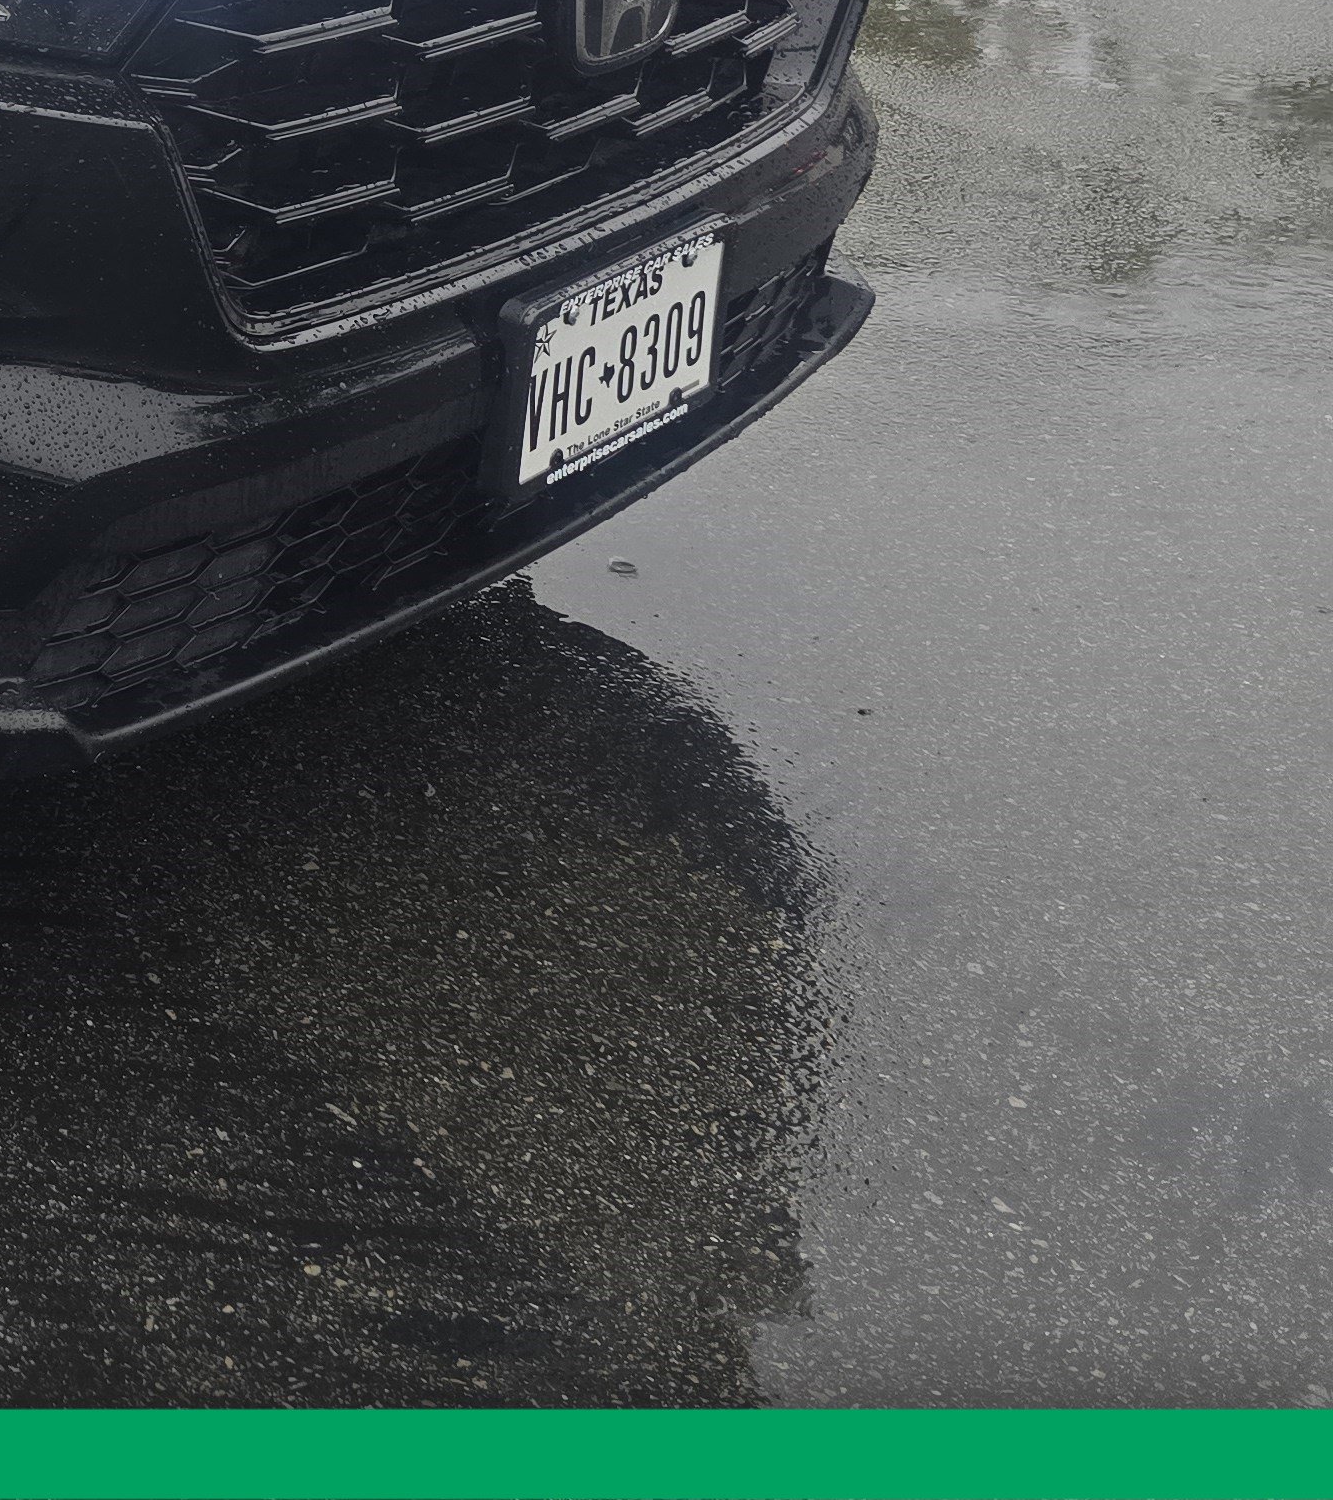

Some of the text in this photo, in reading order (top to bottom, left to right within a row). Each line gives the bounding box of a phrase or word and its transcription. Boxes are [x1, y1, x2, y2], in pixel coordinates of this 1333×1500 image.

[559, 232, 715, 316] ENTERPRISE CAR SALES
[589, 267, 664, 327] TEXAS
[546, 403, 689, 485] enterprisecarsales.com
[566, 399, 661, 456] The Lone Star State
